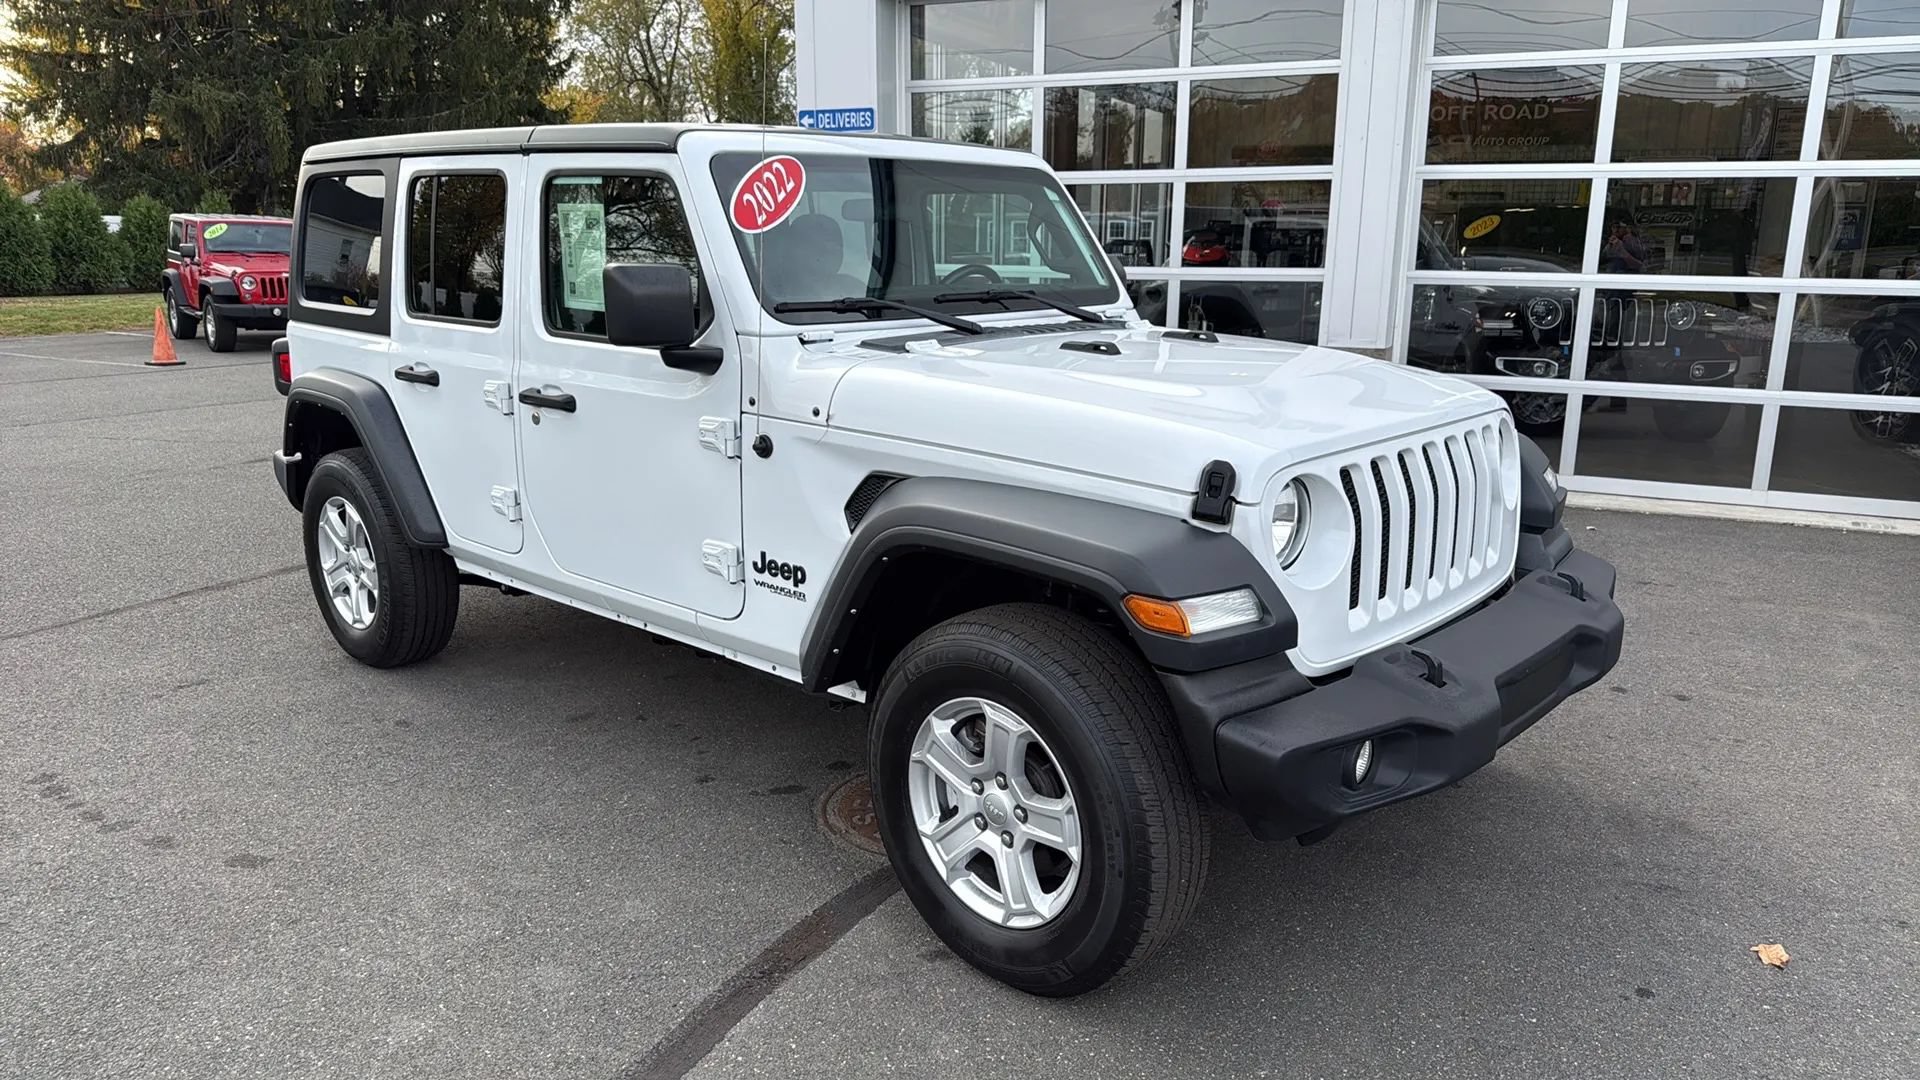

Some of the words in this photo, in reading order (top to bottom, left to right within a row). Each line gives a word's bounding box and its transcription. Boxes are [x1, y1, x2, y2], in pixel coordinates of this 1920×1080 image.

[818, 112, 871, 128] DELIVERIES
[1431, 106, 1475, 122] OFF
[1484, 104, 1549, 120] ROAD
[1473, 137, 1504, 146] AUTO
[1507, 136, 1550, 146] GROUP
[743, 161, 795, 226] 2022
[208, 224, 223, 237] 2014
[1471, 217, 1495, 235] 2023
[752, 551, 807, 588] Jeep
[753, 579, 806, 600] WRANGLER
